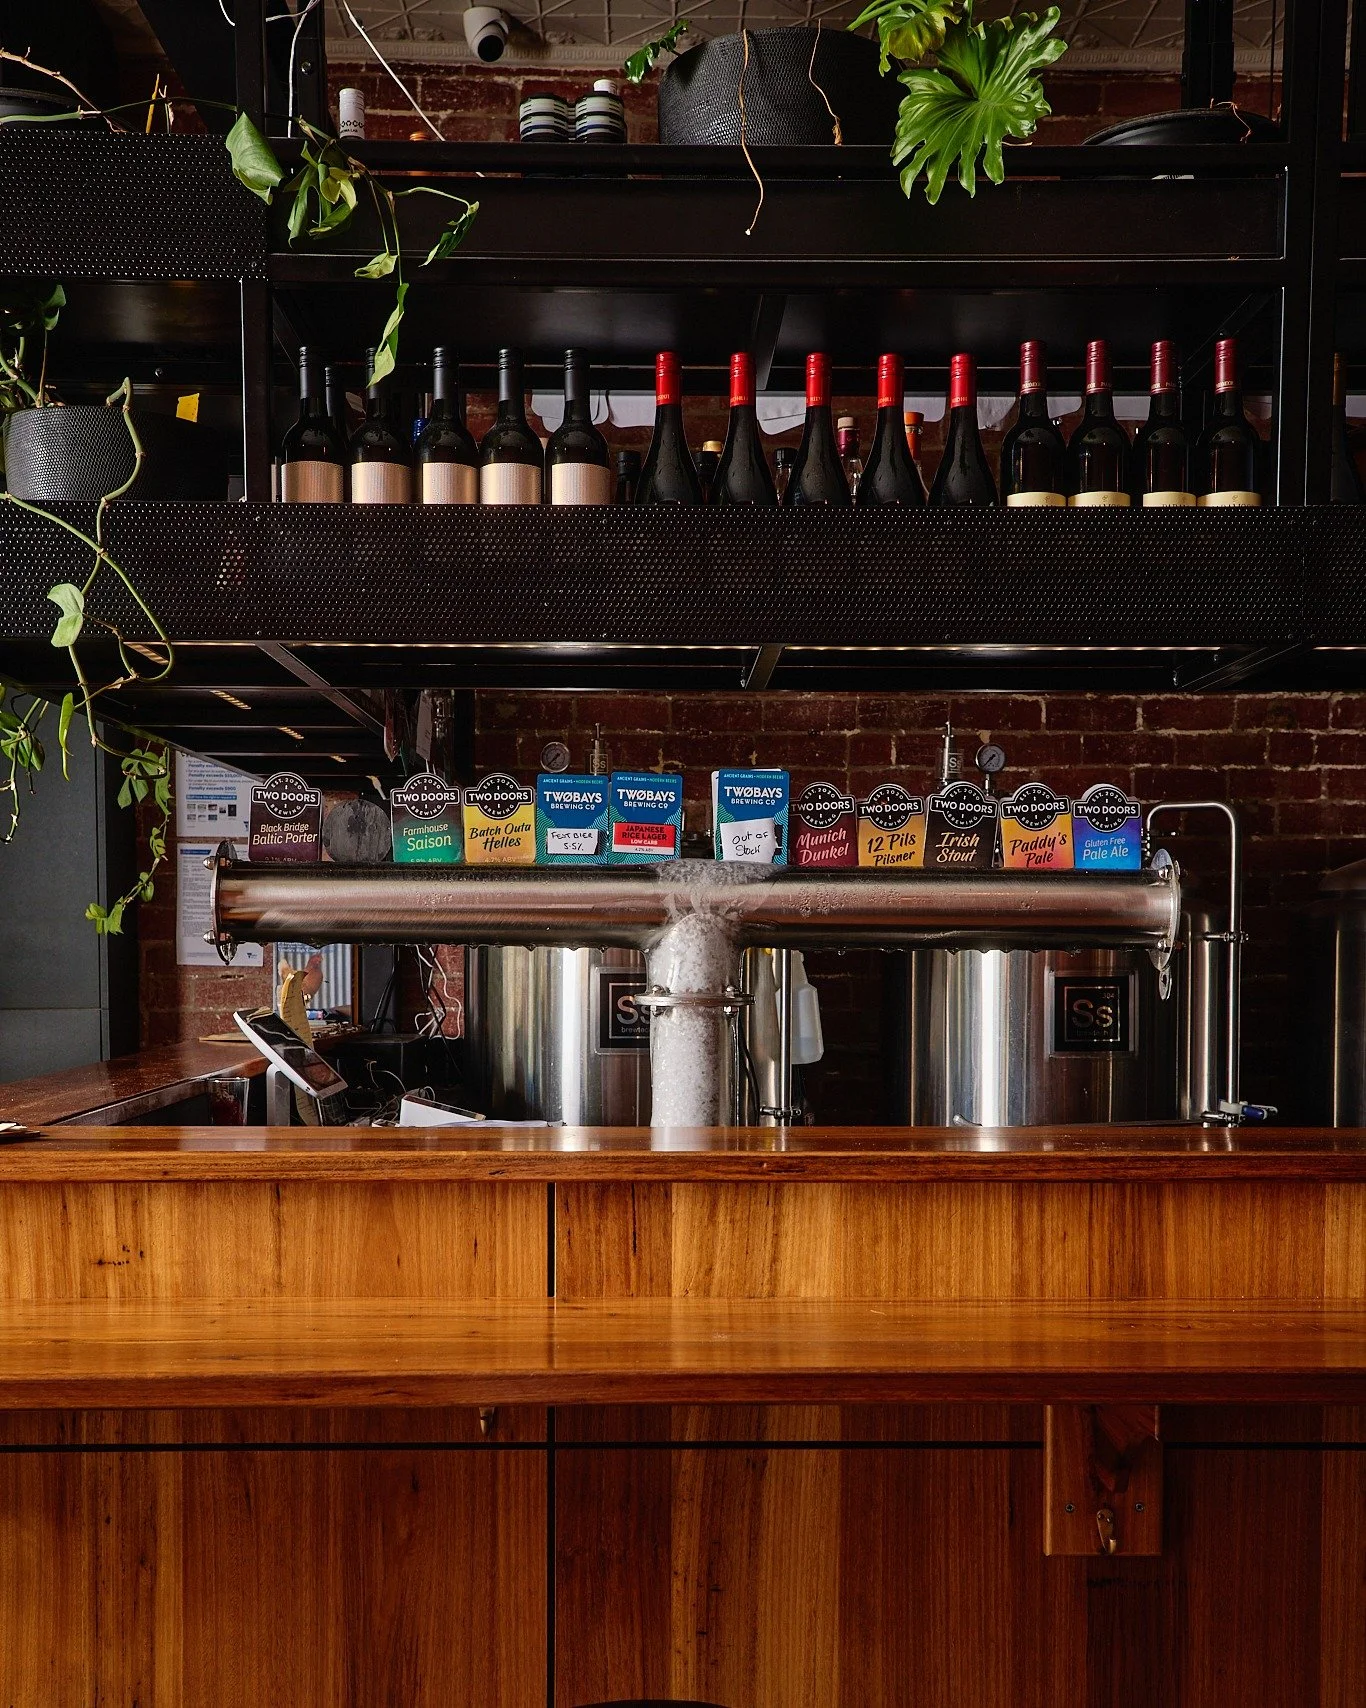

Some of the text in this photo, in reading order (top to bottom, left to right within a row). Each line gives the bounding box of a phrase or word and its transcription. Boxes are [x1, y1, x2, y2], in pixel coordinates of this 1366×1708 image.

[285, 778, 302, 790] 2020
[424, 779, 441, 790] 2020
[497, 779, 514, 789] 2020
[256, 791, 316, 802] TWO DOORS
[396, 792, 455, 802] TWO DOORS
[469, 792, 528, 801] TWO DOORS
[818, 788, 835, 798] 2020
[886, 790, 904, 800] 2020
[964, 788, 980, 801] 2020
[1033, 789, 1051, 800] 2020
[1105, 792, 1122, 803] 2020
[270, 804, 302, 815] BREWING
[411, 805, 441, 816] BREWING
[484, 805, 514, 815] BREWING
[791, 801, 850, 811] TWO DOORS
[860, 802, 919, 814] TWO DOORS
[935, 800, 993, 814] TWO DOORS
[1006, 802, 1065, 814] TWO DOORS
[1077, 806, 1136, 814] TWO DOORS
[806, 814, 837, 825] BREWING
[876, 815, 906, 826] BREWING
[948, 813, 978, 825] BREWING
[1022, 815, 1051, 826] BREWING
[1092, 818, 1122, 829] BREWING
[261, 823, 309, 832] Black Bridge
[403, 823, 449, 837] Farmhouse
[468, 823, 531, 839] Batch Outa
[626, 825, 664, 833] JAPANESE
[253, 833, 318, 845] Baltic Porter
[407, 835, 451, 852] Saison
[483, 836, 521, 852] Helles
[796, 828, 847, 849] Munich
[868, 833, 916, 854] 12 Pils
[935, 833, 980, 848] Irish
[1010, 832, 1067, 856] Paddy's
[1085, 839, 1109, 848] Gluten
[799, 843, 849, 865] Dunkel
[873, 851, 915, 866] Pilsner
[936, 848, 977, 863] Stout
[1083, 845, 1129, 861] Pale Ale
[1025, 851, 1054, 868] Pale
[1072, 1000, 1113, 1028] Ss
